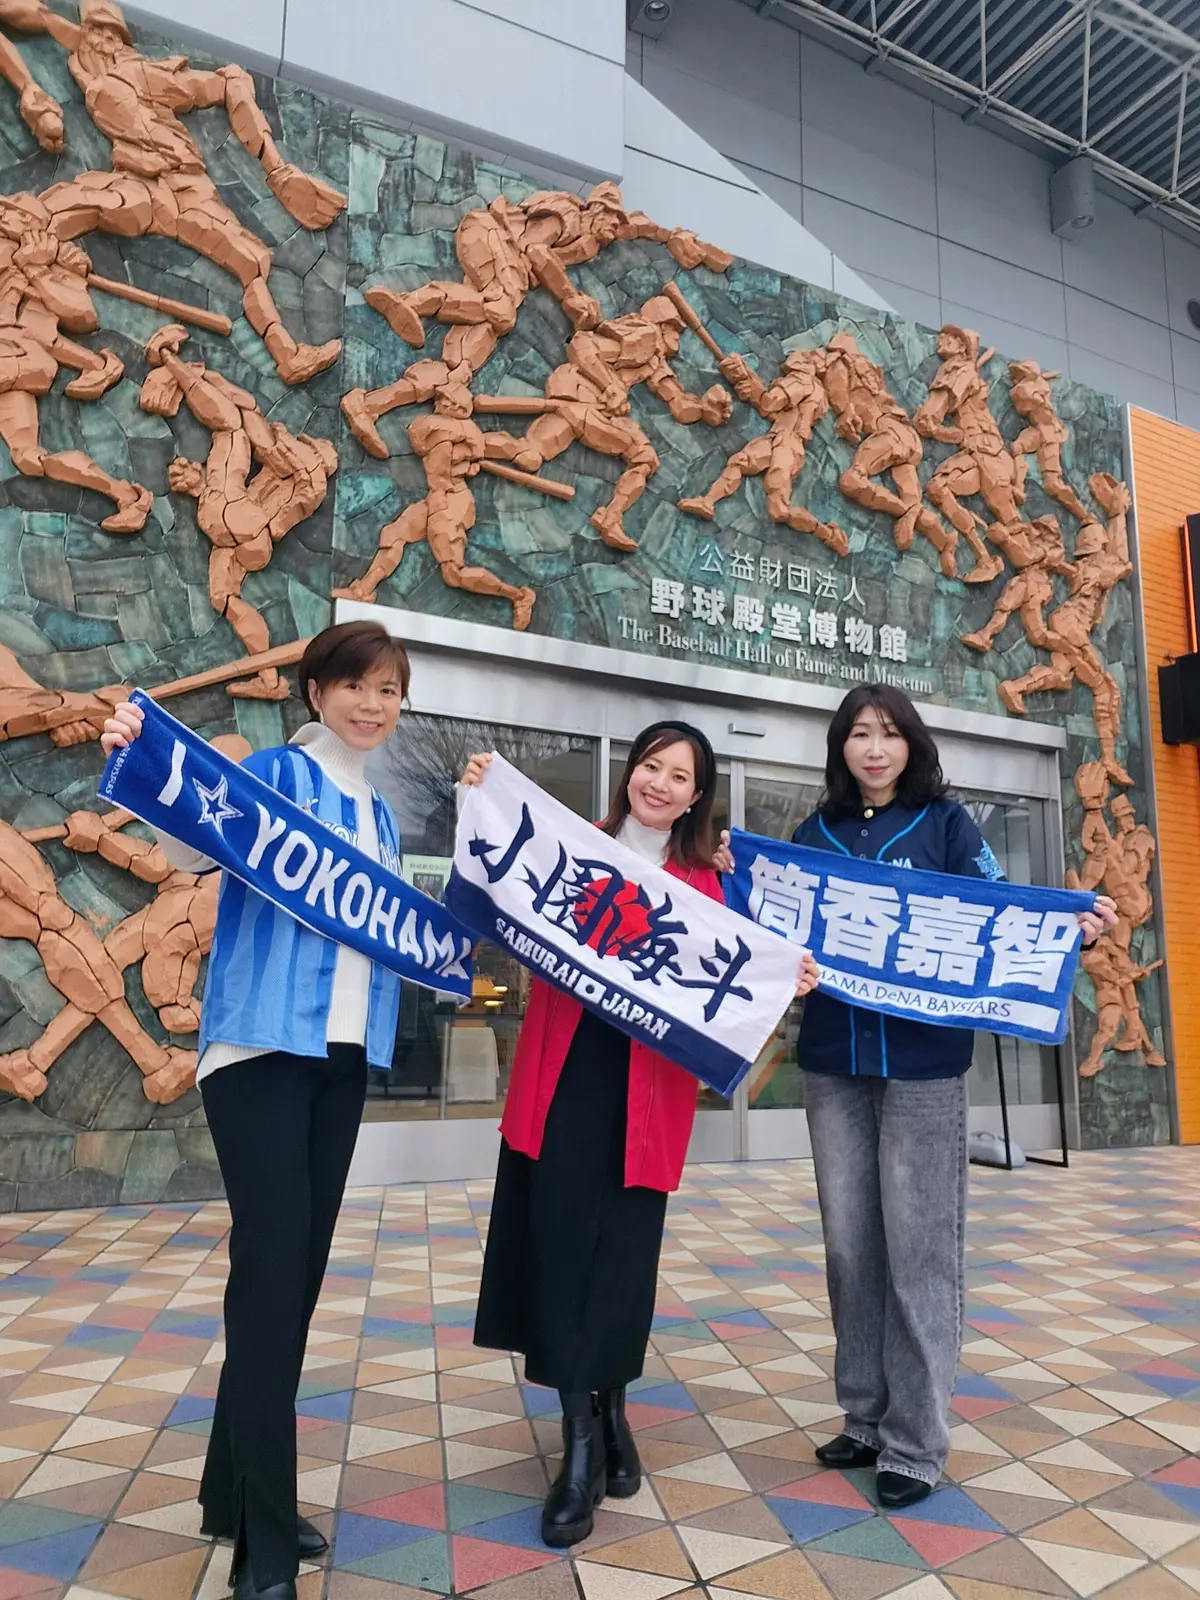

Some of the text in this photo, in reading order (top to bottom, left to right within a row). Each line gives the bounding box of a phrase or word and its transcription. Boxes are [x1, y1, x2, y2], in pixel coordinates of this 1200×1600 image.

[699, 543, 866, 608] 公益財団法人
[617, 615, 933, 694] The Baseball Hall of Fame and Museum
[650, 577, 908, 663] 野球殿堂博物館
[246, 801, 471, 981] YOKOHAMA
[748, 853, 1083, 993] 筒香嘉智
[495, 917, 671, 1041] SAMURAI JAPAN
[875, 986, 922, 1008] DeNA
[926, 996, 1012, 1018] BAYSTARS
